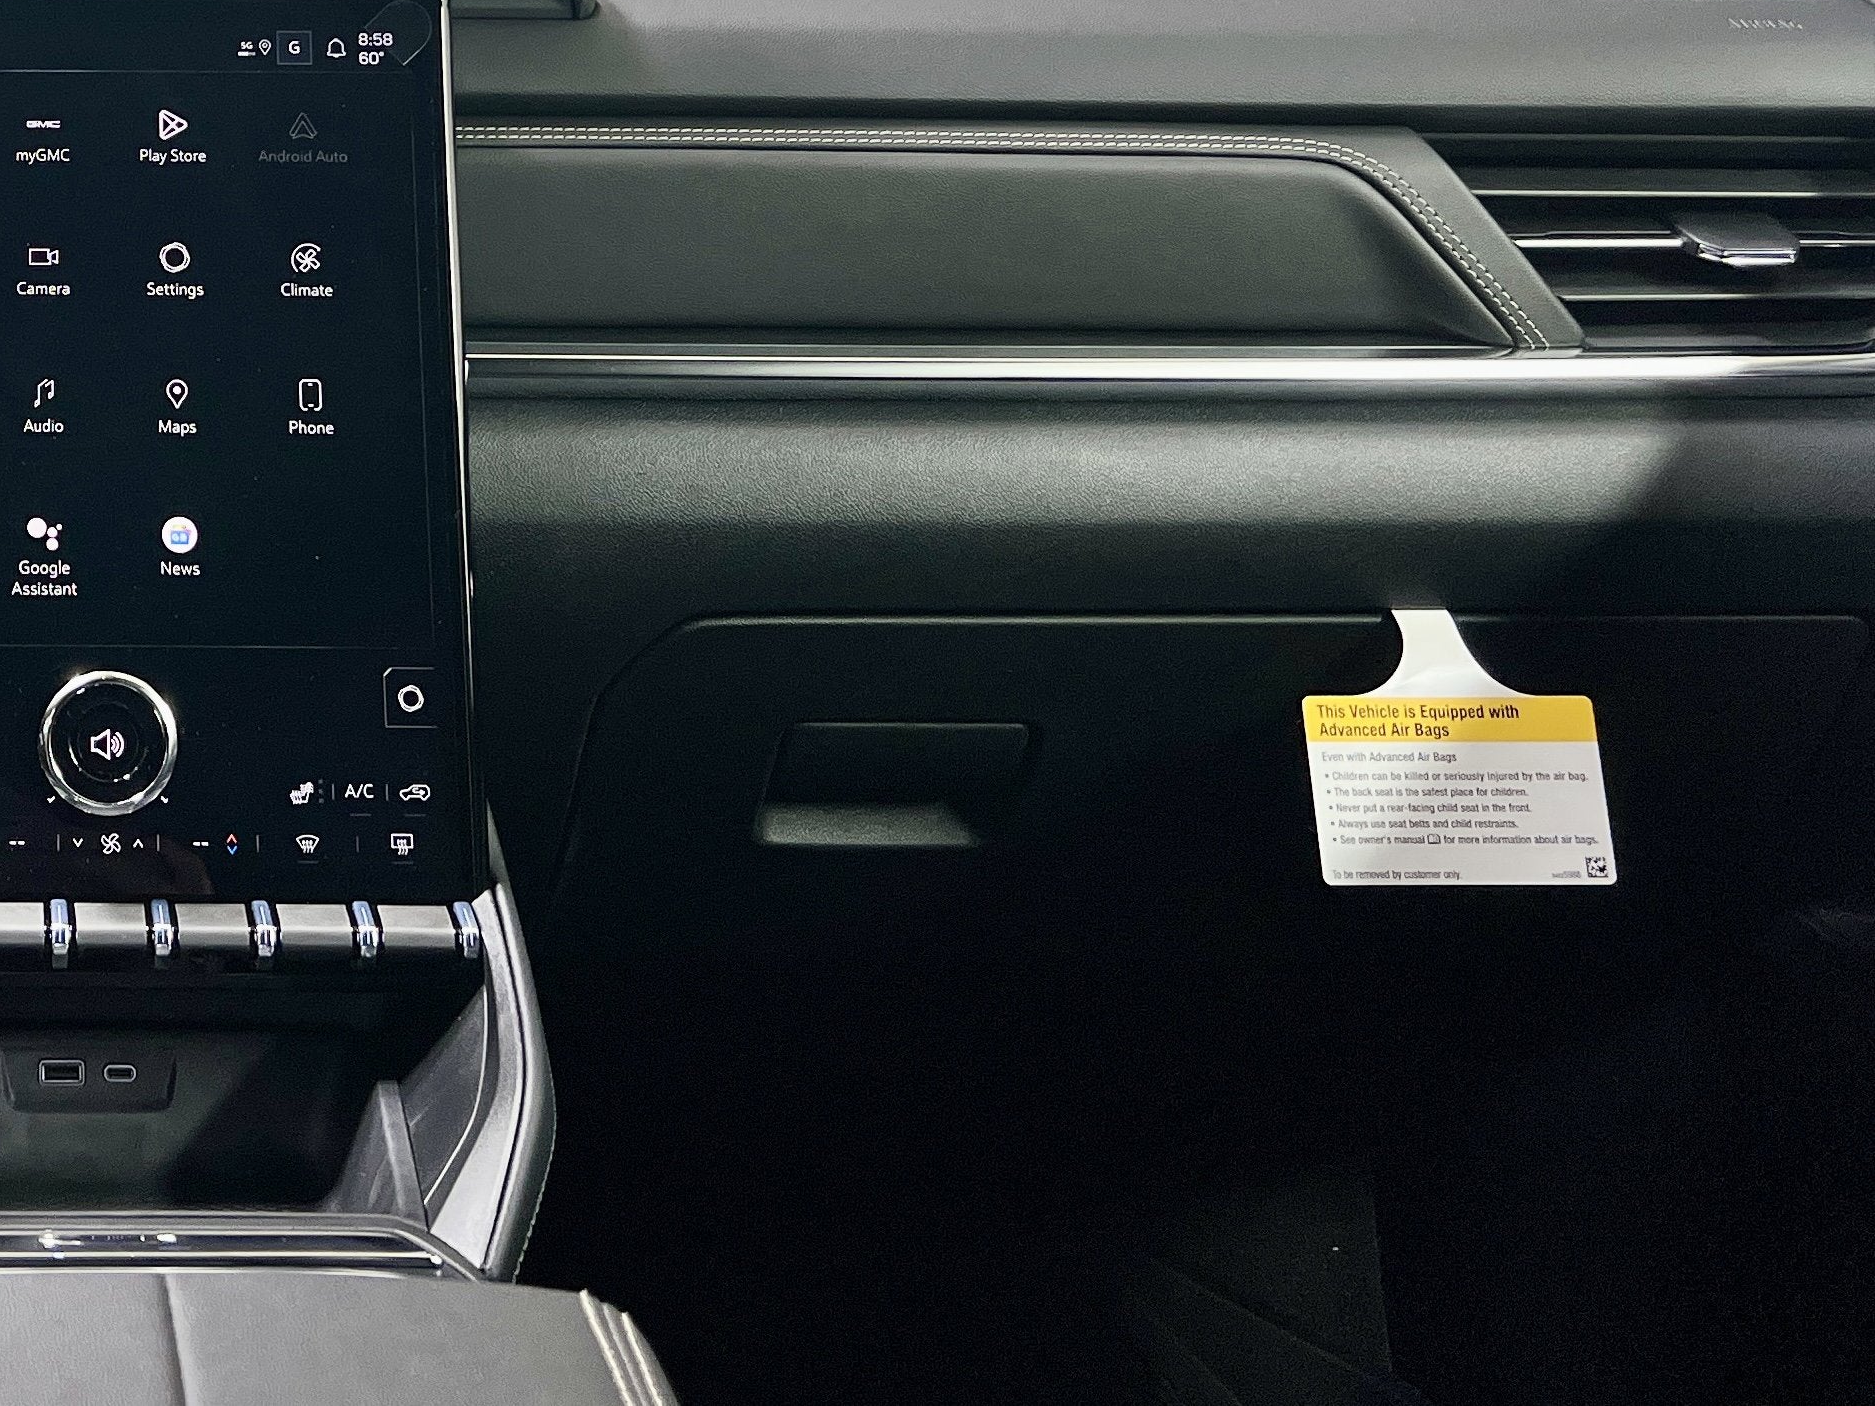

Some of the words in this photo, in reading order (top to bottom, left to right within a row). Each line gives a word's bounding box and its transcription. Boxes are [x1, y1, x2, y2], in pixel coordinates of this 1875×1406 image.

[359, 33, 393, 46] 8:58
[359, 52, 384, 65] 60°
[16, 148, 69, 165] myGMC
[140, 149, 167, 165] Play
[171, 149, 206, 162] Store
[259, 150, 304, 163] Android
[311, 150, 348, 163] Auto
[17, 282, 70, 295] Camera
[147, 282, 204, 299] Settings
[281, 283, 333, 296] Climate
[24, 419, 64, 432] Audio
[159, 420, 197, 437] Maps
[289, 420, 334, 434] Phone
[18, 560, 70, 579] Google
[161, 561, 200, 575] News
[12, 577, 77, 596] Assistant
[1317, 705, 1346, 718] This
[1349, 705, 1399, 719] Vehicle
[1403, 706, 1416, 719] is
[1420, 706, 1484, 722] Equipped
[1488, 706, 1519, 720] with
[1320, 724, 1387, 738] Advanced
[1391, 724, 1410, 737] Air
[1415, 724, 1449, 739] Bags
[1322, 752, 1343, 762] Even
[1346, 752, 1366, 762] with
[1369, 752, 1414, 762] Advanced
[1417, 752, 1430, 762] Air
[1433, 753, 1457, 763] Bags
[1332, 771, 1369, 782] Children
[1372, 773, 1387, 781] can
[1390, 772, 1403, 781] be
[1405, 771, 1429, 782] killed
[1431, 773, 1441, 781] or
[1444, 772, 1484, 783] seriously
[1487, 772, 1519, 783] injured
[1522, 772, 1533, 783] by
[1536, 772, 1550, 782] the
[1553, 772, 1566, 782] air
[1568, 772, 1589, 783] bag.
[345, 784, 374, 798] A/C
[1334, 787, 1350, 796] The
[1352, 787, 1373, 796] back
[1375, 788, 1393, 797] seat
[1395, 788, 1403, 797] is
[1405, 788, 1419, 797] the
[1422, 787, 1448, 797] safest
[1450, 788, 1474, 799] place
[1476, 788, 1487, 797] for
[1490, 788, 1528, 798] children.
[1336, 803, 1361, 813] Never
[1363, 804, 1377, 815] put
[1387, 803, 1435, 815] rear-facing
[1437, 803, 1458, 813] child
[1461, 804, 1479, 813] seat
[1482, 804, 1490, 813] in
[1492, 804, 1507, 813] the
[1508, 803, 1531, 813] front.
[1338, 819, 1368, 830] Always
[1388, 819, 1406, 829] seat
[1407, 819, 1430, 829] belts
[1433, 819, 1449, 829] and
[1451, 819, 1472, 829] child
[1475, 819, 1519, 829] restraints.
[1340, 835, 1356, 845] See
[1358, 834, 1391, 845] owner's
[1394, 835, 1425, 845] manual
[1444, 835, 1455, 844] for
[1458, 836, 1480, 844] more
[1483, 834, 1532, 845] information
[1534, 835, 1559, 845] about
[1561, 835, 1572, 845] air
[1575, 835, 1599, 846] bags.
[1343, 870, 1354, 879] be
[1356, 870, 1390, 880] removed
[1393, 870, 1402, 882] by
[1404, 870, 1441, 880] customer
